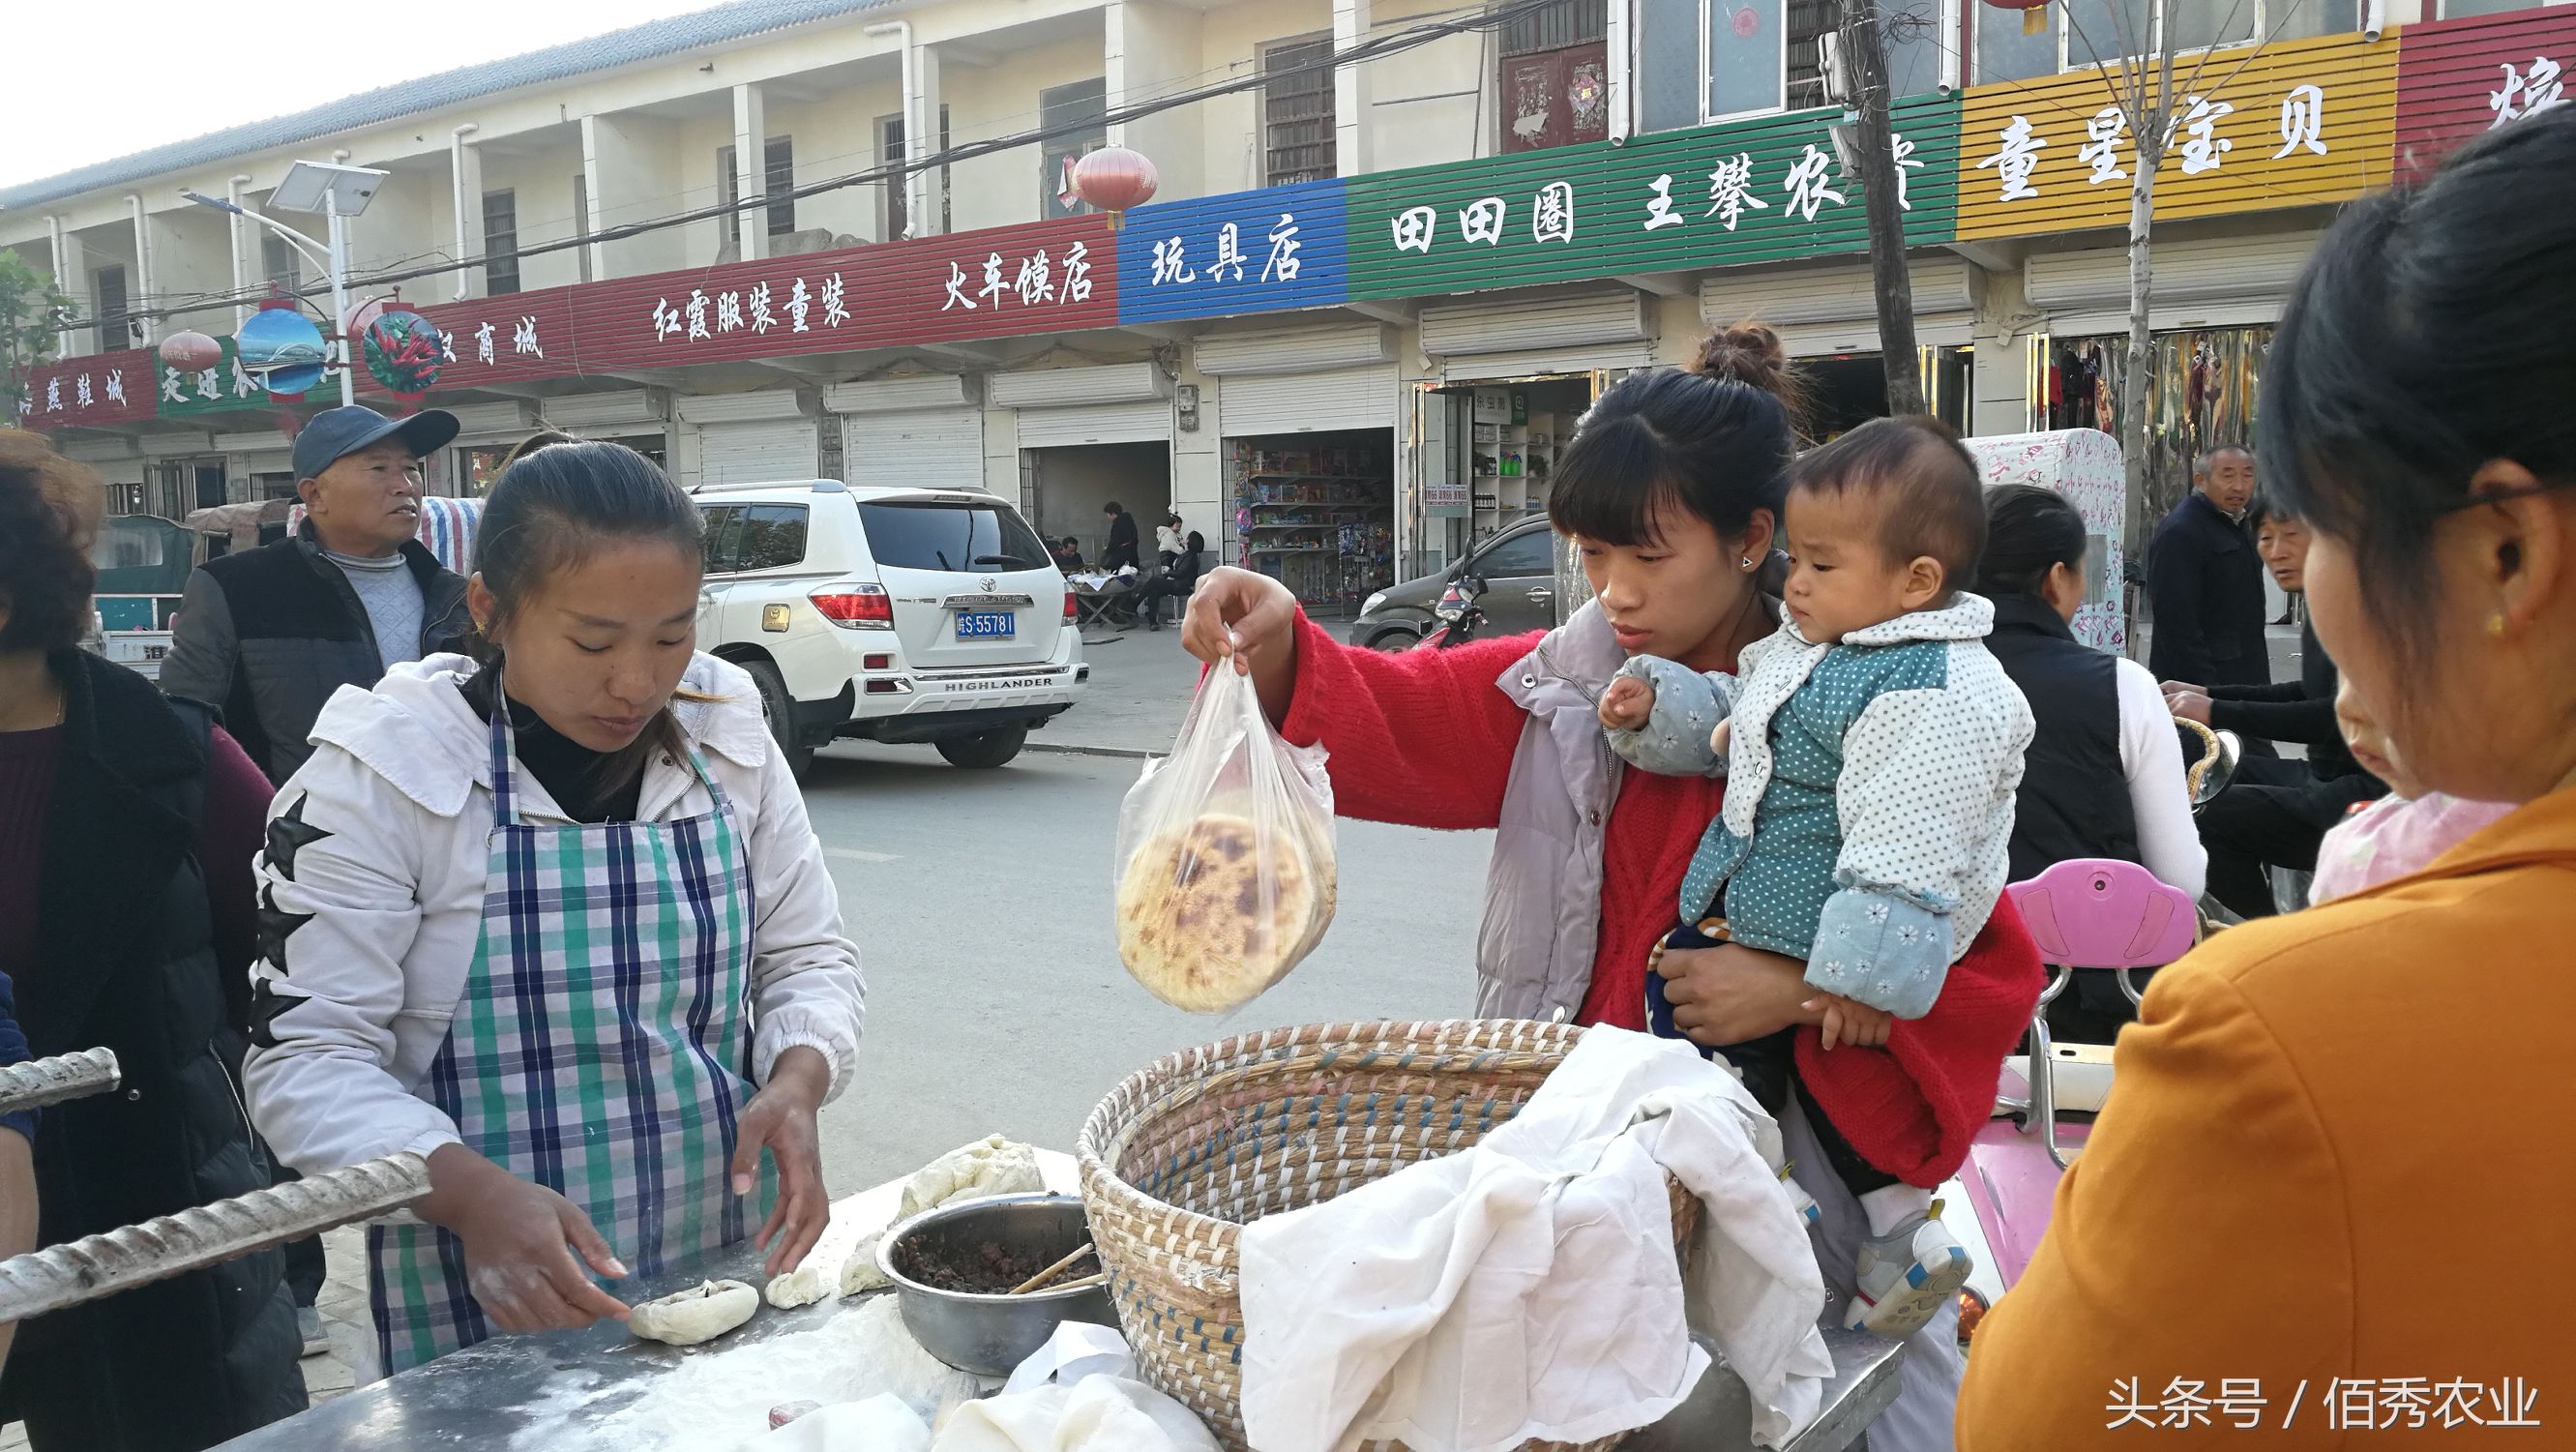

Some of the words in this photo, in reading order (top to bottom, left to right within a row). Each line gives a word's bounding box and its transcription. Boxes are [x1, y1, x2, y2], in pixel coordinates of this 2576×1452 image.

[1976, 84, 2327, 202] 童星宝贝
[1151, 213, 1301, 287] 玩具店
[1391, 182, 1574, 253] 田田圈
[653, 273, 850, 342] 红霞服装童装
[941, 242, 1092, 311] 火车馍店
[945, 679, 1052, 691] HIGHLANDER
